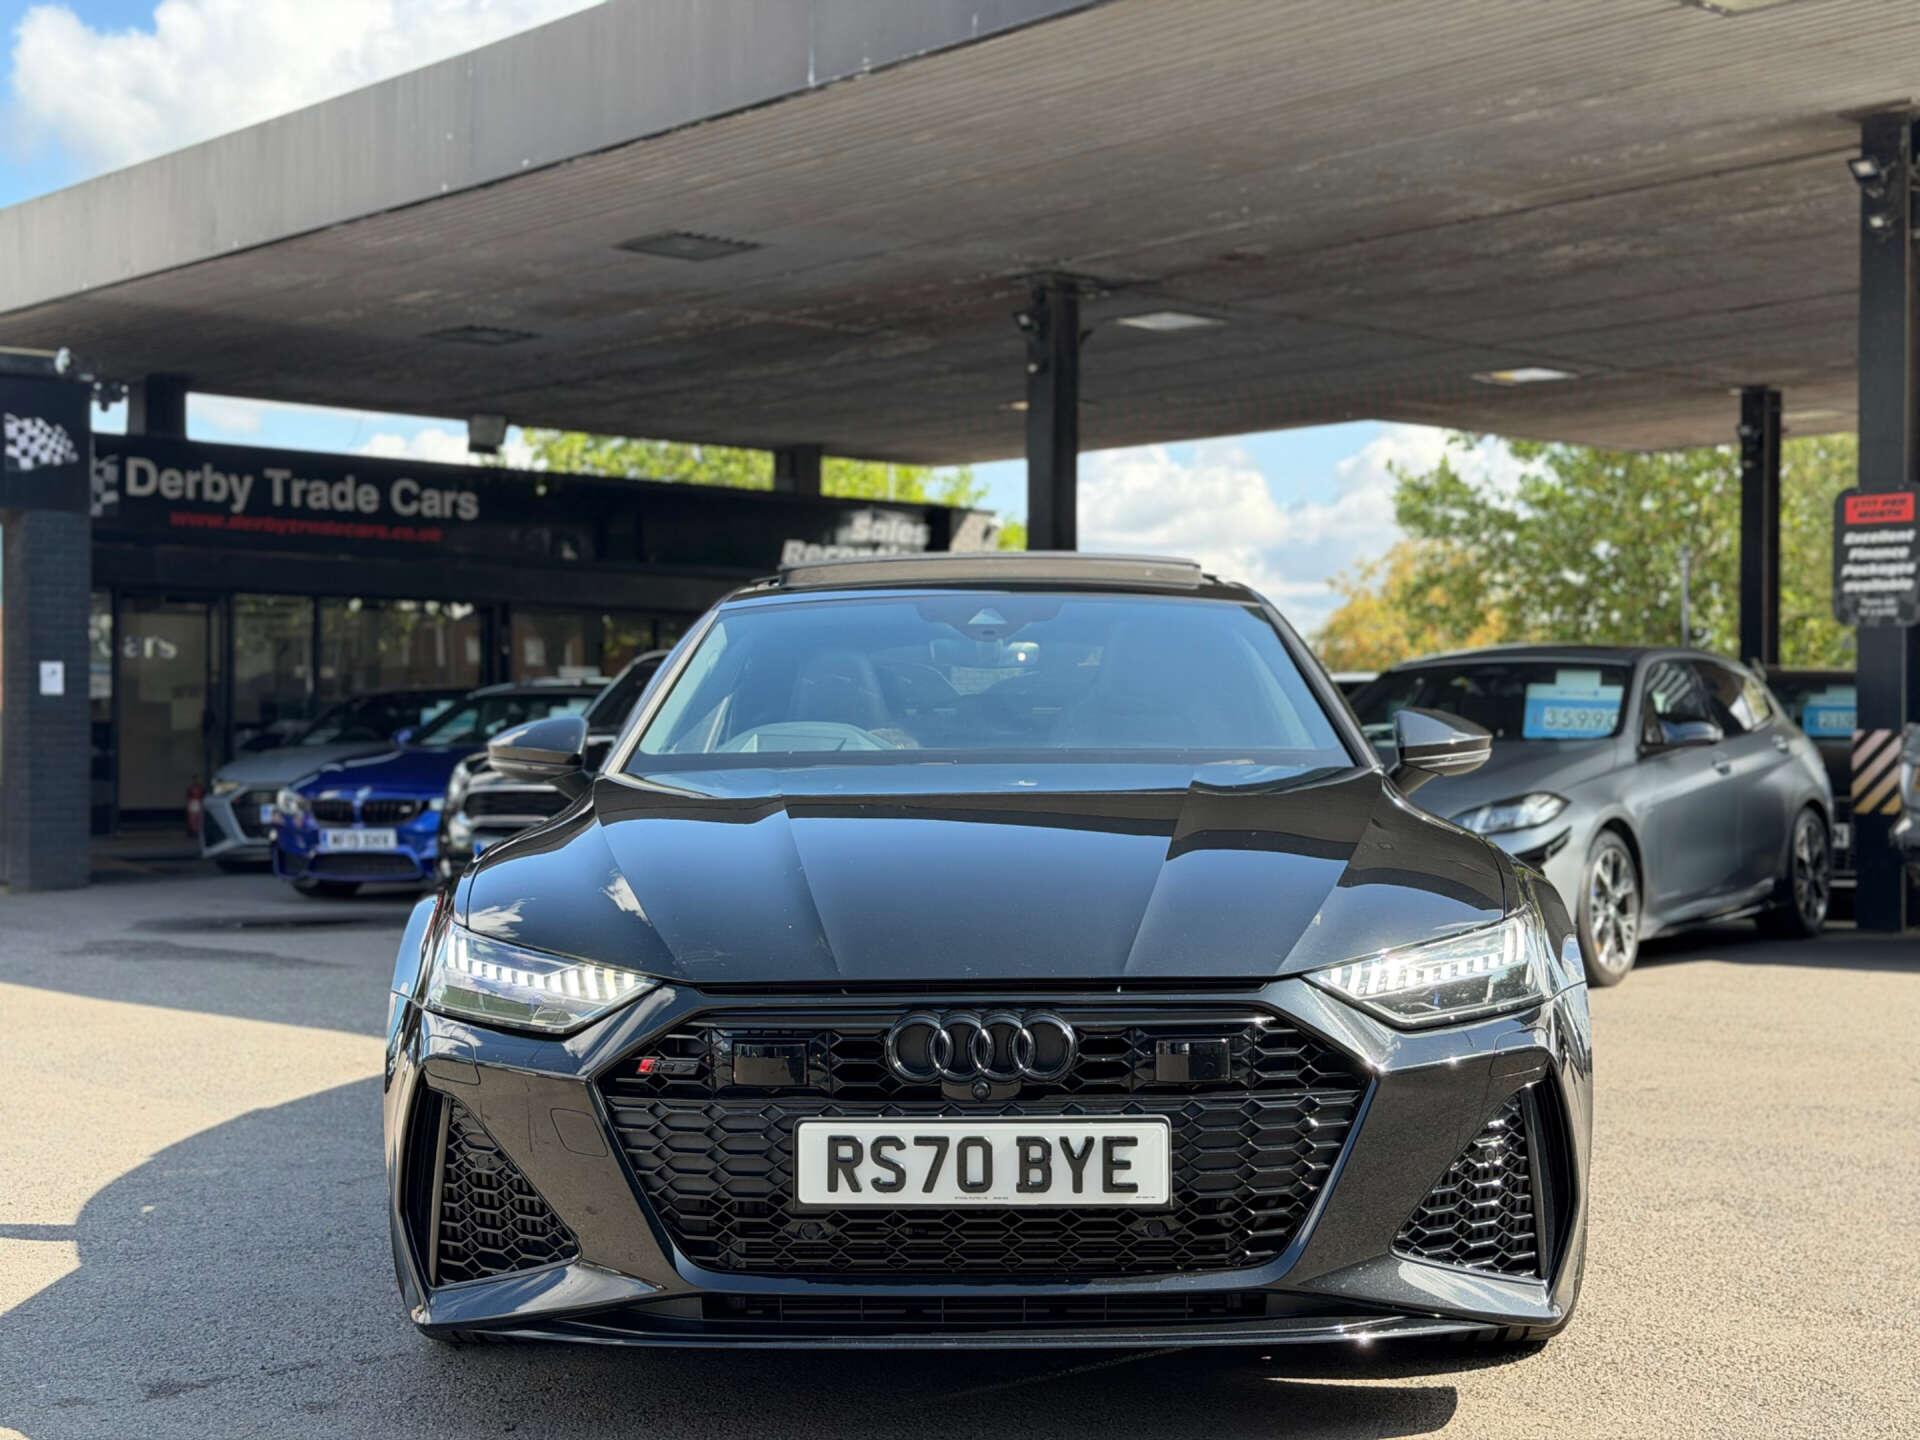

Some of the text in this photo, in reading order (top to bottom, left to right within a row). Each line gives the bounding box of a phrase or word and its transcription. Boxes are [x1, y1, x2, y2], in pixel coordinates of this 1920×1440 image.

[125, 456, 480, 521] Derby Trade Cars
[850, 510, 929, 546] Sales
[827, 1135, 1139, 1194] RS70 BYE
